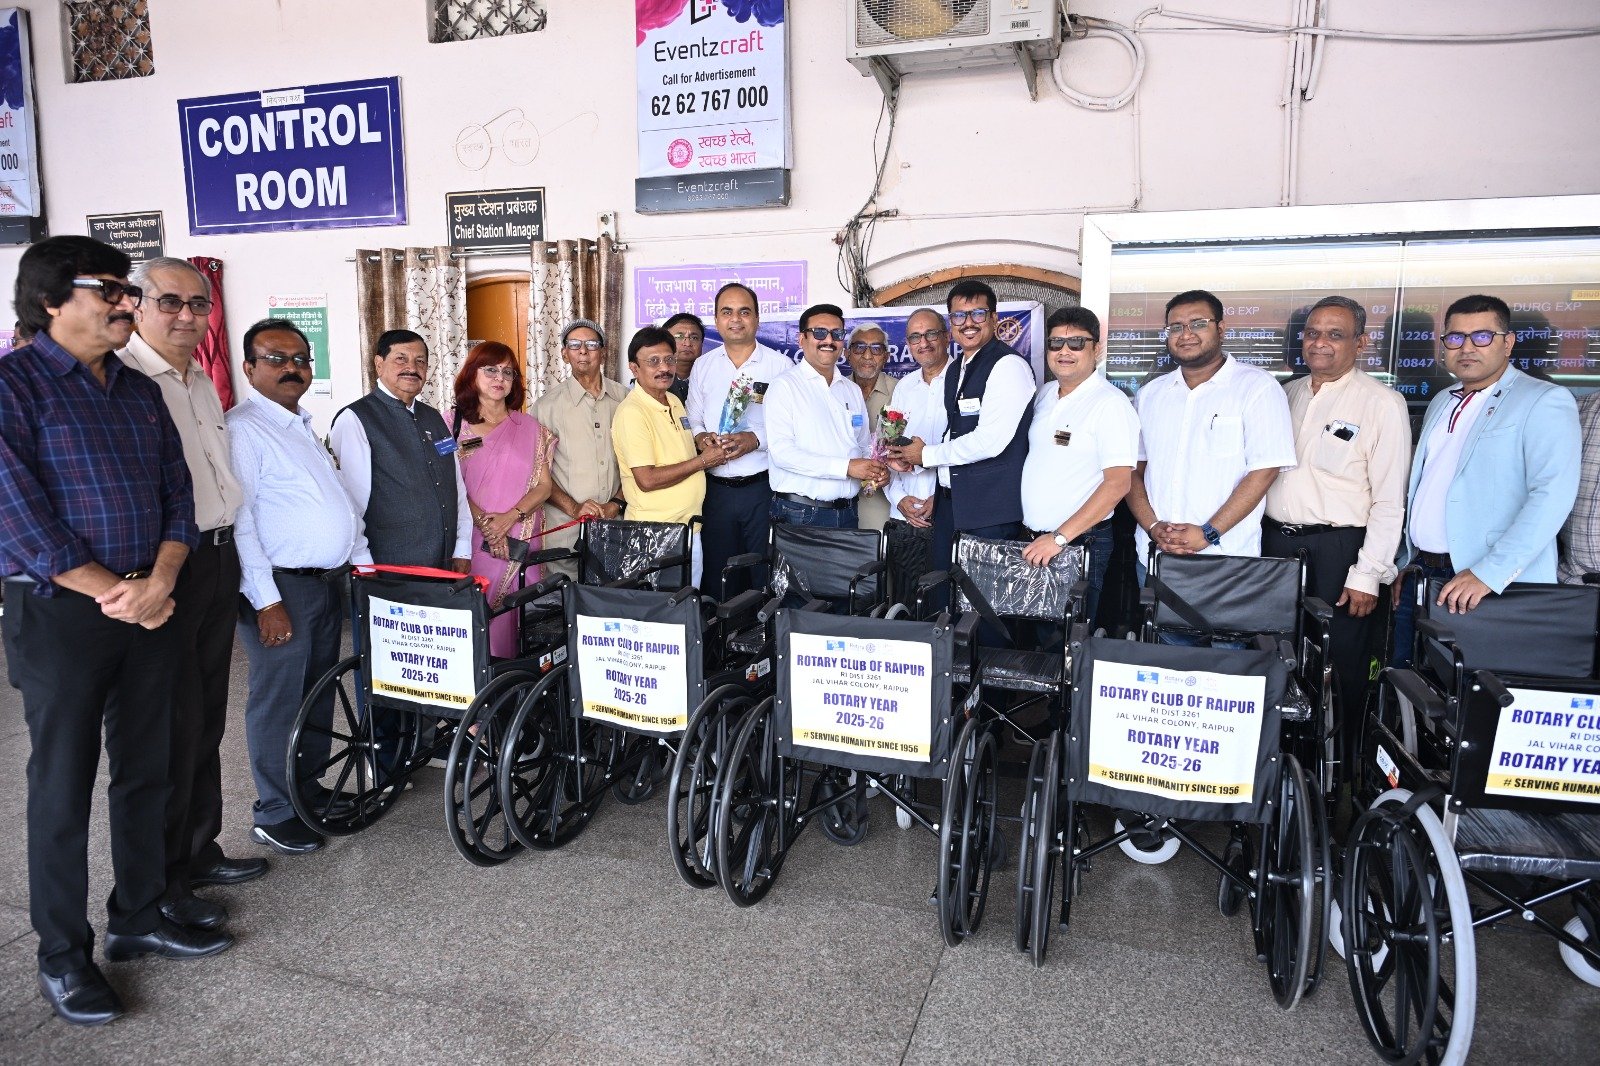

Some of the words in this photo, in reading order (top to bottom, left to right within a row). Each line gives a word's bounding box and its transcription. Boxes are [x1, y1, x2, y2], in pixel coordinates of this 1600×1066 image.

[654, 30, 763, 62] Eventzcraft
[663, 74, 678, 86] Call
[681, 72, 693, 84] for
[695, 66, 756, 83] Advertisement
[651, 95, 671, 116] 62
[676, 92, 696, 114] 62
[701, 89, 731, 112] 767
[737, 85, 769, 109] 000
[198, 102, 382, 158] CONTROL
[698, 135, 727, 149] स्वच्छ
[730, 128, 754, 147] रेल्वे,
[1, 153, 19, 171] 000
[698, 154, 727, 168] स्वच्छ
[730, 151, 756, 165] भारत
[235, 165, 348, 212] ROOM
[677, 179, 739, 194] Eventzcraft
[453, 203, 475, 222] मुख्य
[477, 198, 504, 216] स्टेशन
[506, 197, 538, 215] प्रबंधक
[94, 222, 104, 230] उप
[106, 220, 126, 230] स्टेशन
[127, 218, 157, 229] अधीक्षक
[454, 224, 475, 239] Chief
[476, 223, 504, 238] Station
[505, 222, 540, 240] Manager
[109, 230, 143, 240] (वाणिज्य)
[700, 279, 717, 292] का
[645, 298, 666, 318] हिंदी
[670, 298, 681, 315] से
[1111, 307, 1144, 317] 18425
[1238, 306, 1259, 315] EXP
[1371, 305, 1387, 314] 02
[1513, 302, 1552, 312] DURG
[1555, 301, 1582, 312] EXP
[1110, 332, 1141, 341] 12261
[1369, 331, 1385, 340] 05
[1400, 331, 1436, 341] 12261
[1109, 356, 1141, 365] 20847
[1157, 354, 1171, 367] दुर्ग
[1367, 357, 1382, 365] 05
[1397, 358, 1435, 368] 20847
[1519, 358, 1530, 369] सु
[1553, 355, 1597, 369] एक्सप्रेस
[1130, 376, 1138, 390] है
[1421, 381, 1430, 395] है
[373, 615, 399, 630] ROTARY
[401, 622, 421, 634] CLUB
[423, 625, 434, 635] OF
[436, 626, 468, 638] RAIPUR
[437, 645, 456, 653] RAIPUR
[582, 634, 615, 647] ROTARY
[633, 641, 644, 652] OF
[646, 642, 680, 655] RAIPUR
[391, 651, 424, 666] ROTARY
[426, 656, 448, 670] YEAR
[645, 663, 666, 671] RAIPUR
[797, 655, 837, 668] ROTARY
[841, 658, 867, 671] CLUB
[870, 660, 882, 672] OF
[885, 661, 925, 677] RAIPUR
[401, 667, 439, 684] 2025-26
[606, 669, 632, 686] ROTARY
[634, 675, 658, 690] YEAR
[384, 684, 406, 694] SERVING
[406, 688, 434, 699] HUMANITY
[435, 693, 452, 701] SINCE
[452, 695, 467, 704] 1956
[827, 679, 848, 687] VIHAR
[883, 684, 909, 693] RAIPUR
[614, 687, 647, 705] 2025-26
[823, 692, 867, 709] ROTARY
[870, 697, 898, 713] YEAR
[1100, 685, 1148, 702] ROTARY
[1151, 691, 1184, 707] CLUB
[1187, 694, 1203, 708] OF
[1206, 697, 1255, 714] RAIPUR
[595, 704, 617, 715] SERVING
[641, 715, 659, 724] SINCE
[660, 717, 677, 725] 1956
[836, 711, 884, 730] 2025-26
[1161, 708, 1180, 717] DIST
[1182, 710, 1200, 718] 3261
[1511, 709, 1575, 728] ROTARY
[1116, 712, 1130, 720] JAL
[1132, 714, 1159, 724] VIHAR
[1202, 722, 1235, 733] RAIPUR
[810, 731, 839, 743] SERVING
[841, 736, 876, 749] HUMANITY
[877, 741, 898, 751] SINCE
[900, 744, 919, 753] 1956
[1127, 729, 1181, 750] ROTARY
[1185, 736, 1220, 755] YEAR
[1570, 732, 1580, 740] RI
[1528, 740, 1545, 749] JAL
[1549, 741, 1583, 752] VIHAR
[1141, 750, 1202, 772] 2025-26
[1499, 751, 1569, 772] ROTARY
[1109, 770, 1145, 784] SERVING
[1146, 776, 1190, 792] HUMANITY
[1191, 783, 1217, 794] SINCE
[1219, 785, 1239, 795] 1956
[1503, 778, 1512, 787] #
[1514, 778, 1560, 791] SERVING
